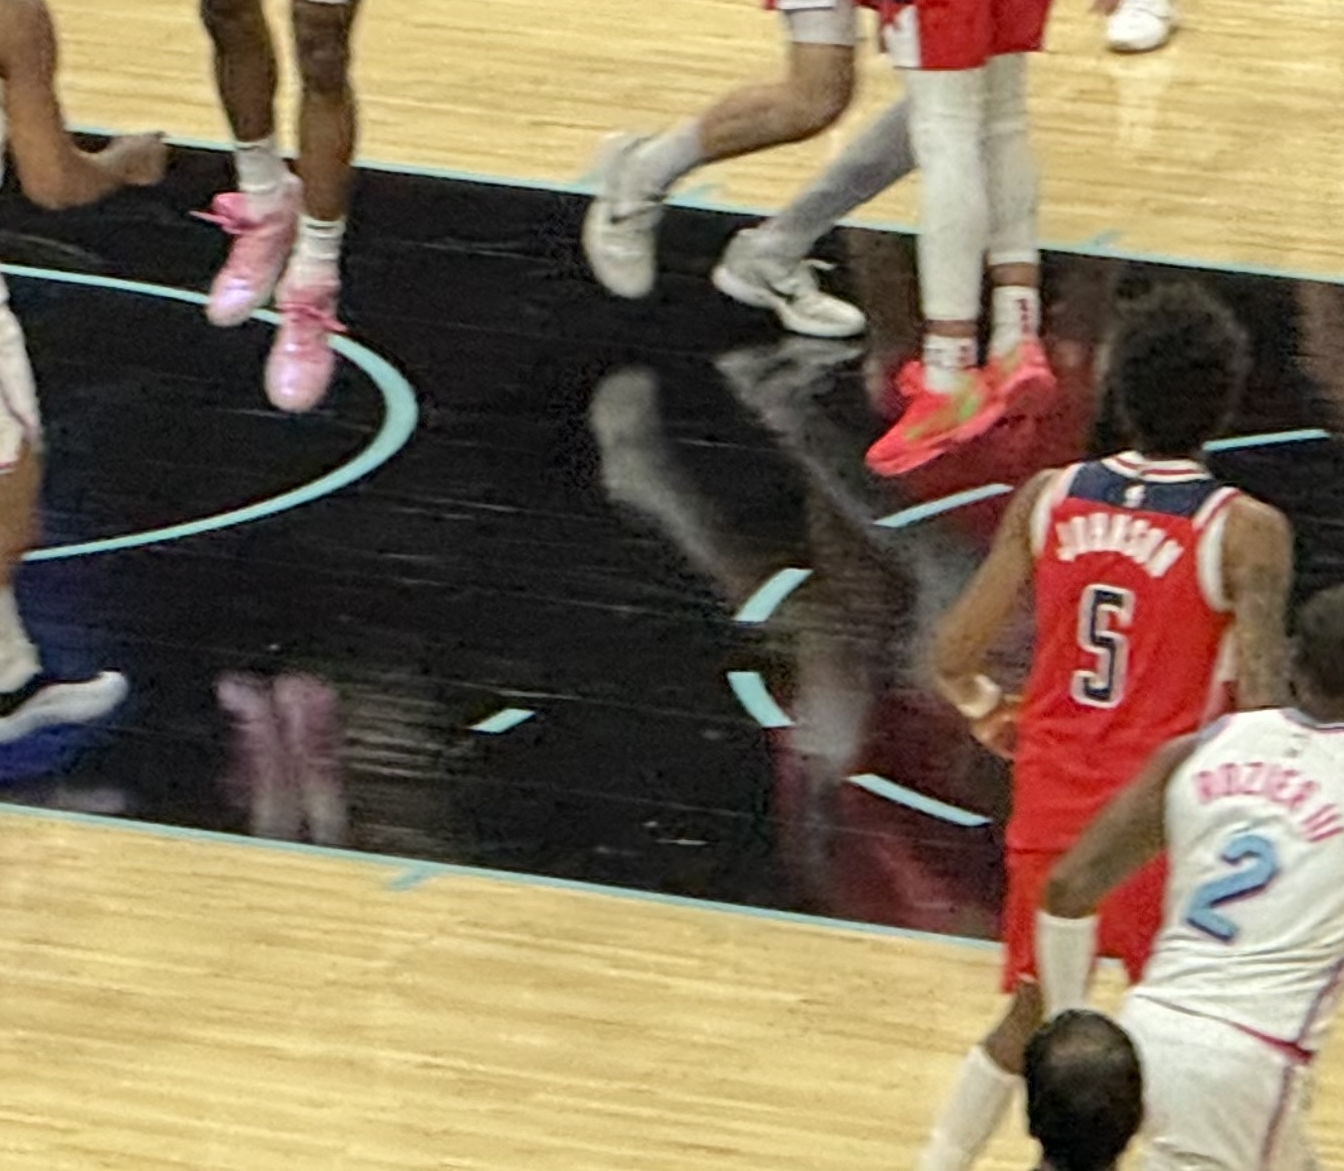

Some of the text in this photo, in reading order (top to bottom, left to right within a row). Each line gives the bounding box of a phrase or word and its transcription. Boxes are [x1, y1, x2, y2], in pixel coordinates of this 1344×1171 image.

[1055, 511, 1185, 578] JOHNSON
[1069, 582, 1138, 710] 5
[1195, 760, 1321, 810] ROZIER
[1184, 833, 1281, 944] 2
